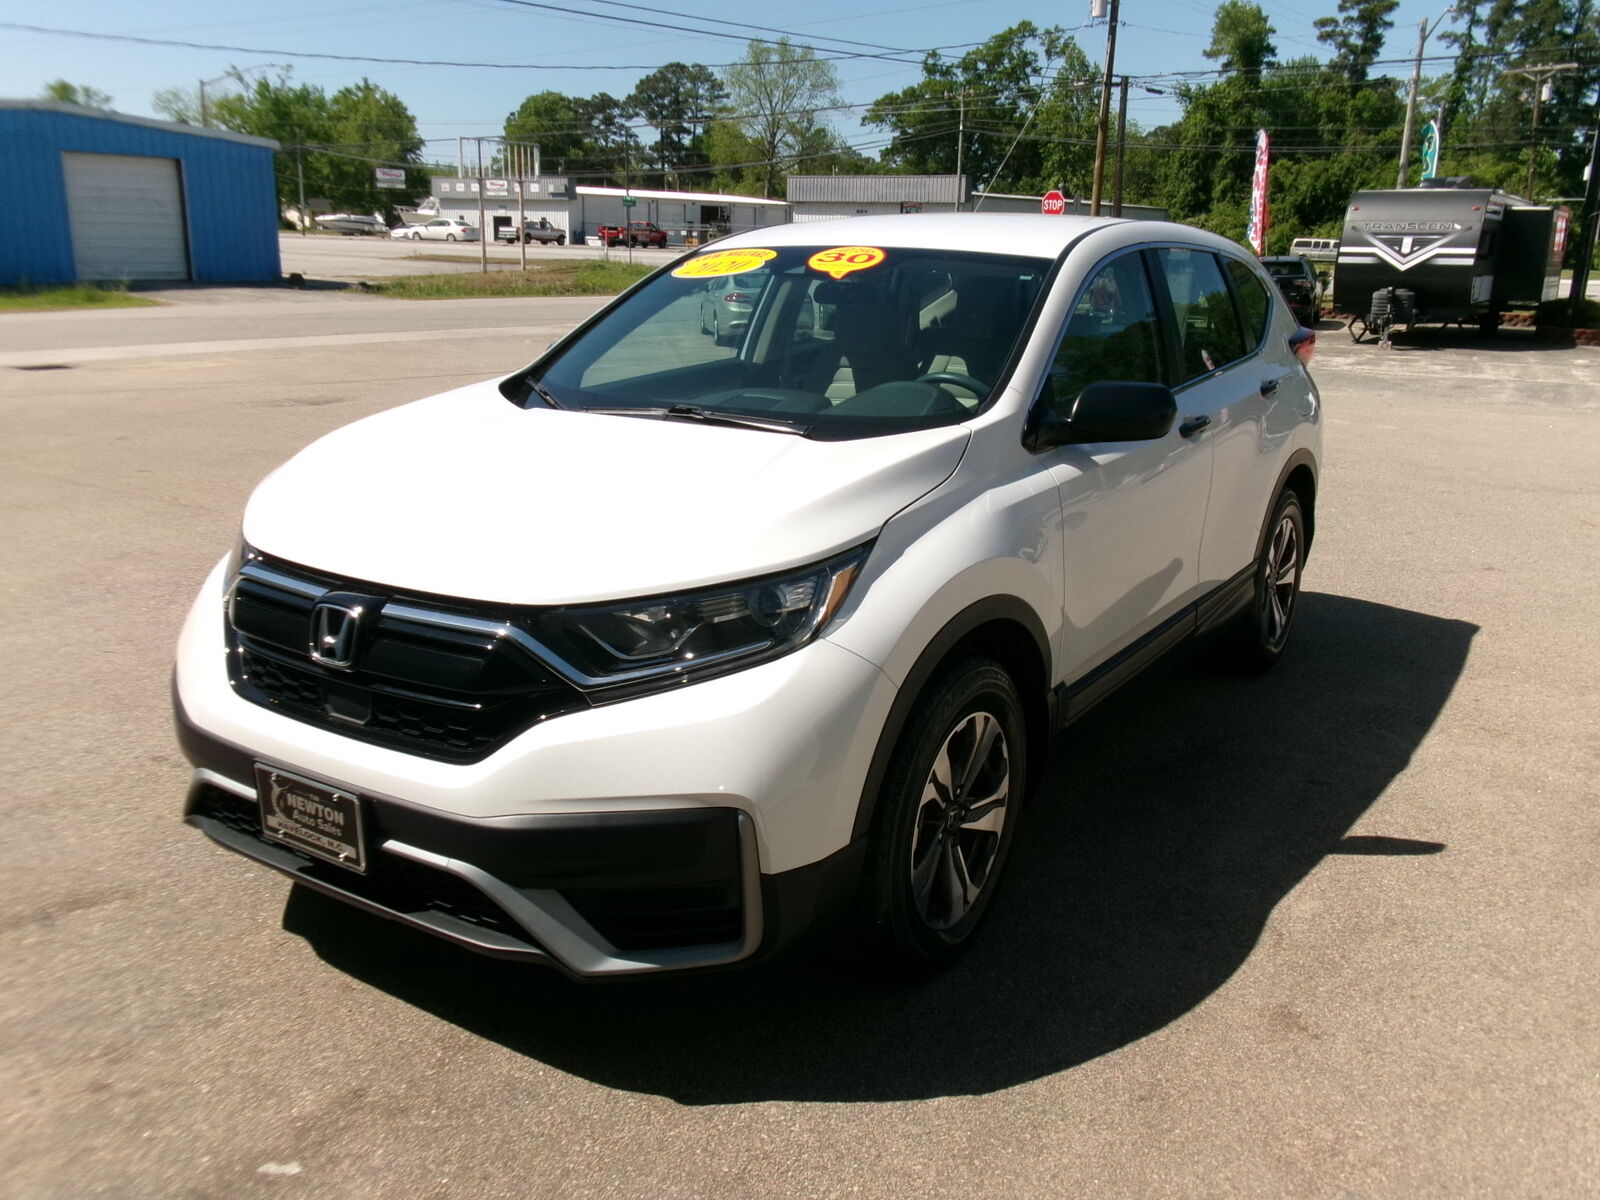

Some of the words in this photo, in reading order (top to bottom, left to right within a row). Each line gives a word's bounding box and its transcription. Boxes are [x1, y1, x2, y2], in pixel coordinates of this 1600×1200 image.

[1043, 200, 1063, 210] STOP
[816, 252, 877, 264] 30
[286, 792, 345, 826] NEWTON
[292, 809, 316, 827] Auto
[317, 818, 342, 837] Sales
